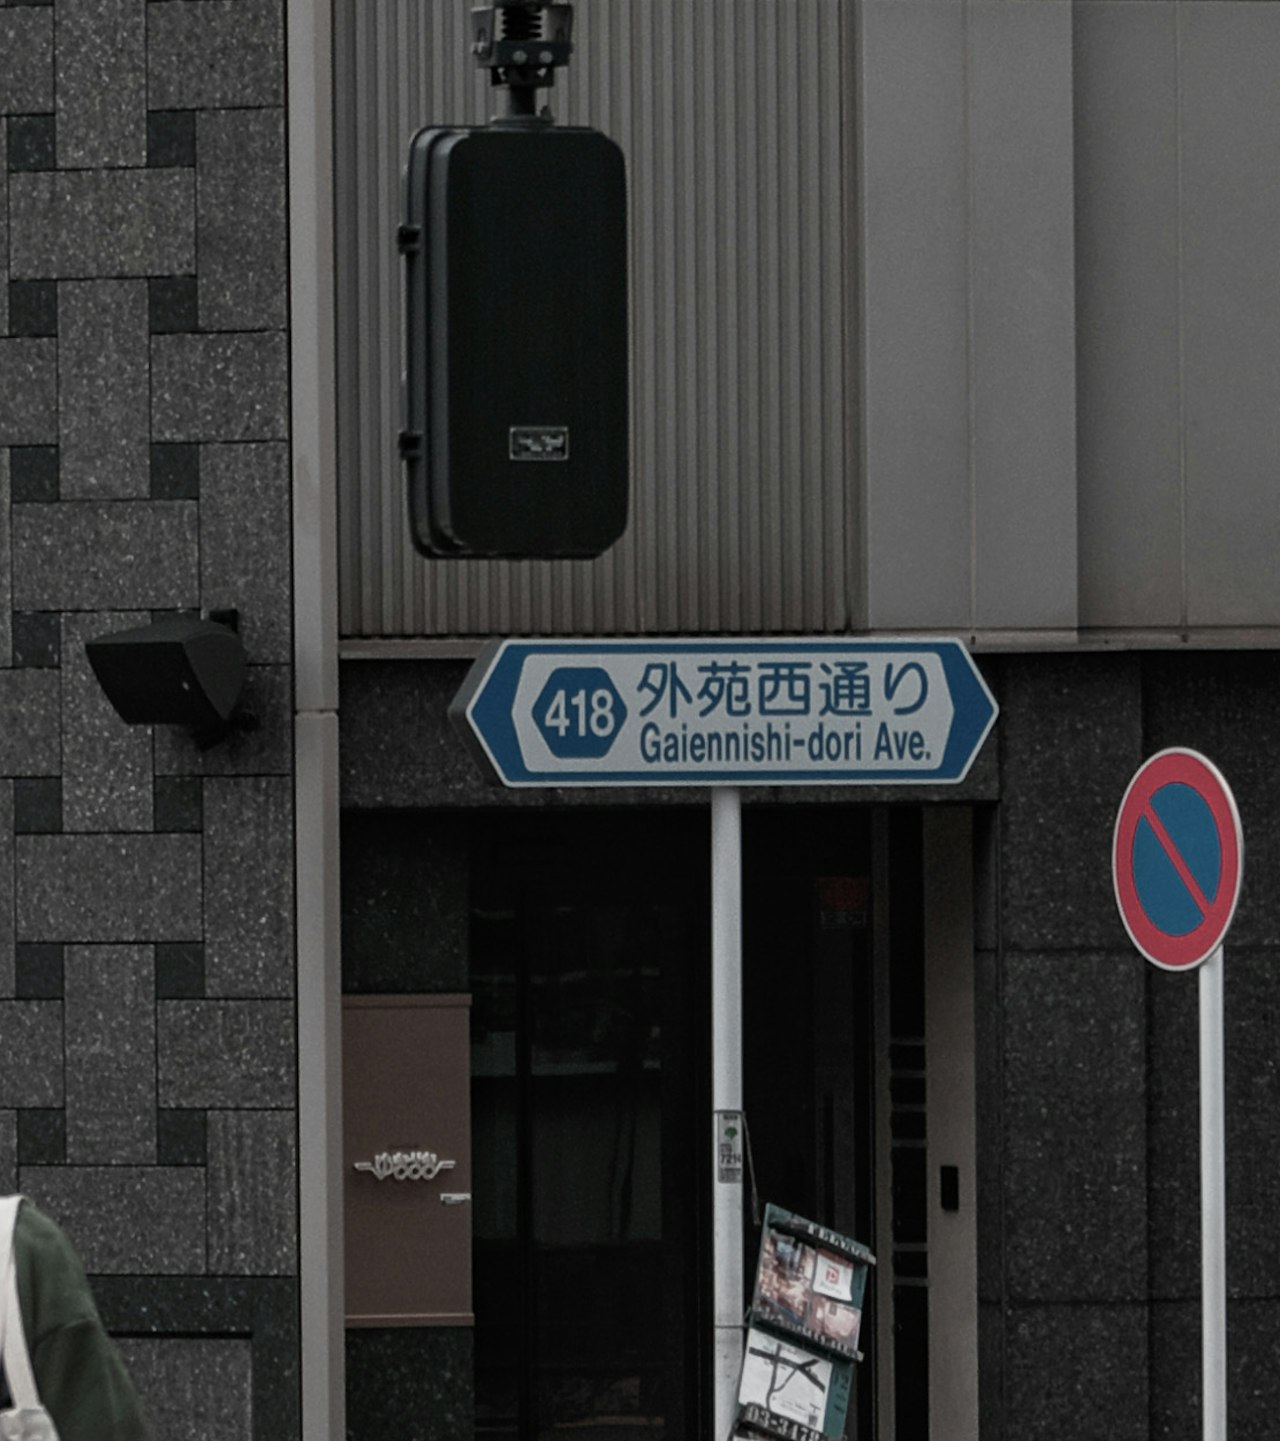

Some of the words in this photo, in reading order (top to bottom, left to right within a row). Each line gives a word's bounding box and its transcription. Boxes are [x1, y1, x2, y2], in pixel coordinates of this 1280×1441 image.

[543, 688, 616, 738] 418
[636, 660, 930, 718] 外苑西通り
[639, 721, 863, 765] Gaiennishi-dori
[874, 722, 932, 762] Ave.
